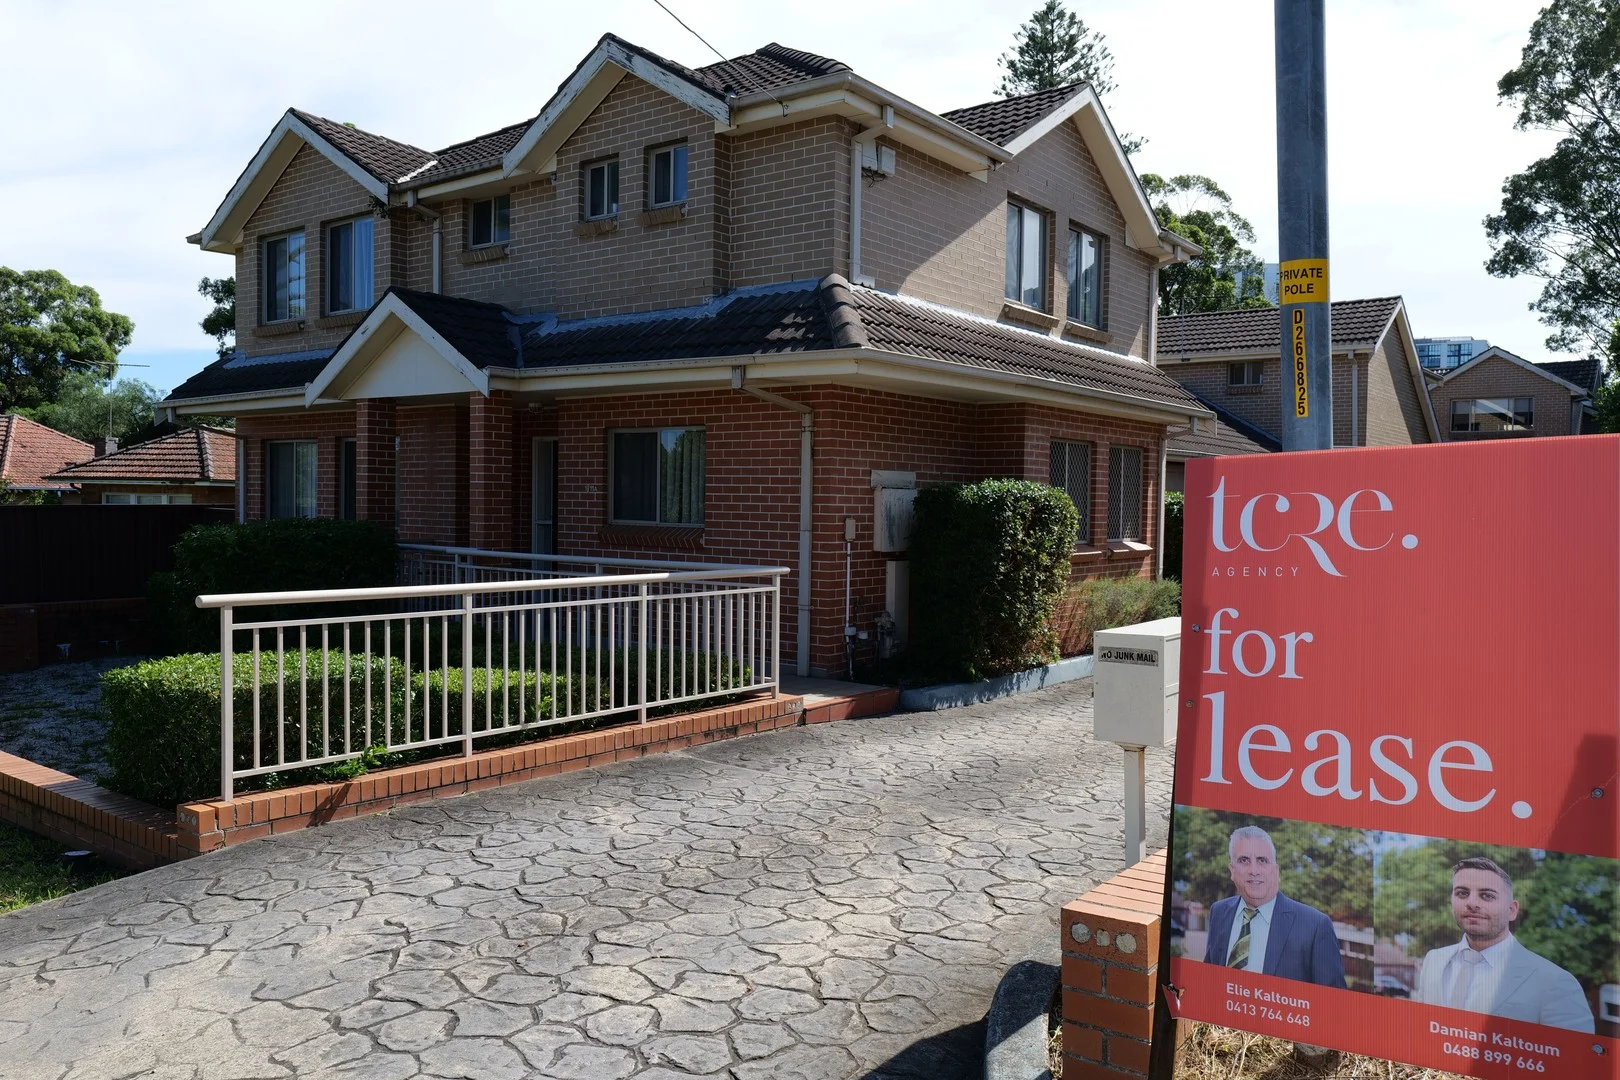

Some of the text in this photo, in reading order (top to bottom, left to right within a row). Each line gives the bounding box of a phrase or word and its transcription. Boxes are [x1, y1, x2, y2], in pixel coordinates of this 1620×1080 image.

[1280, 267, 1323, 281] PRIVATE
[1284, 283, 1314, 296] POLE
[1293, 309, 1306, 416] D266825
[1211, 566, 1300, 578] AGENCY
[1101, 650, 1156, 663] NO JUNK MAIL
[1202, 607, 1314, 680] for
[1200, 690, 1533, 820] lease.
[1226, 982, 1310, 1010] Elie Kaltoum
[1226, 1000, 1310, 1027] 0413 764 648
[1429, 1020, 1560, 1057] Damian Kaltoum
[1443, 1041, 1545, 1073] 0488 899 666
